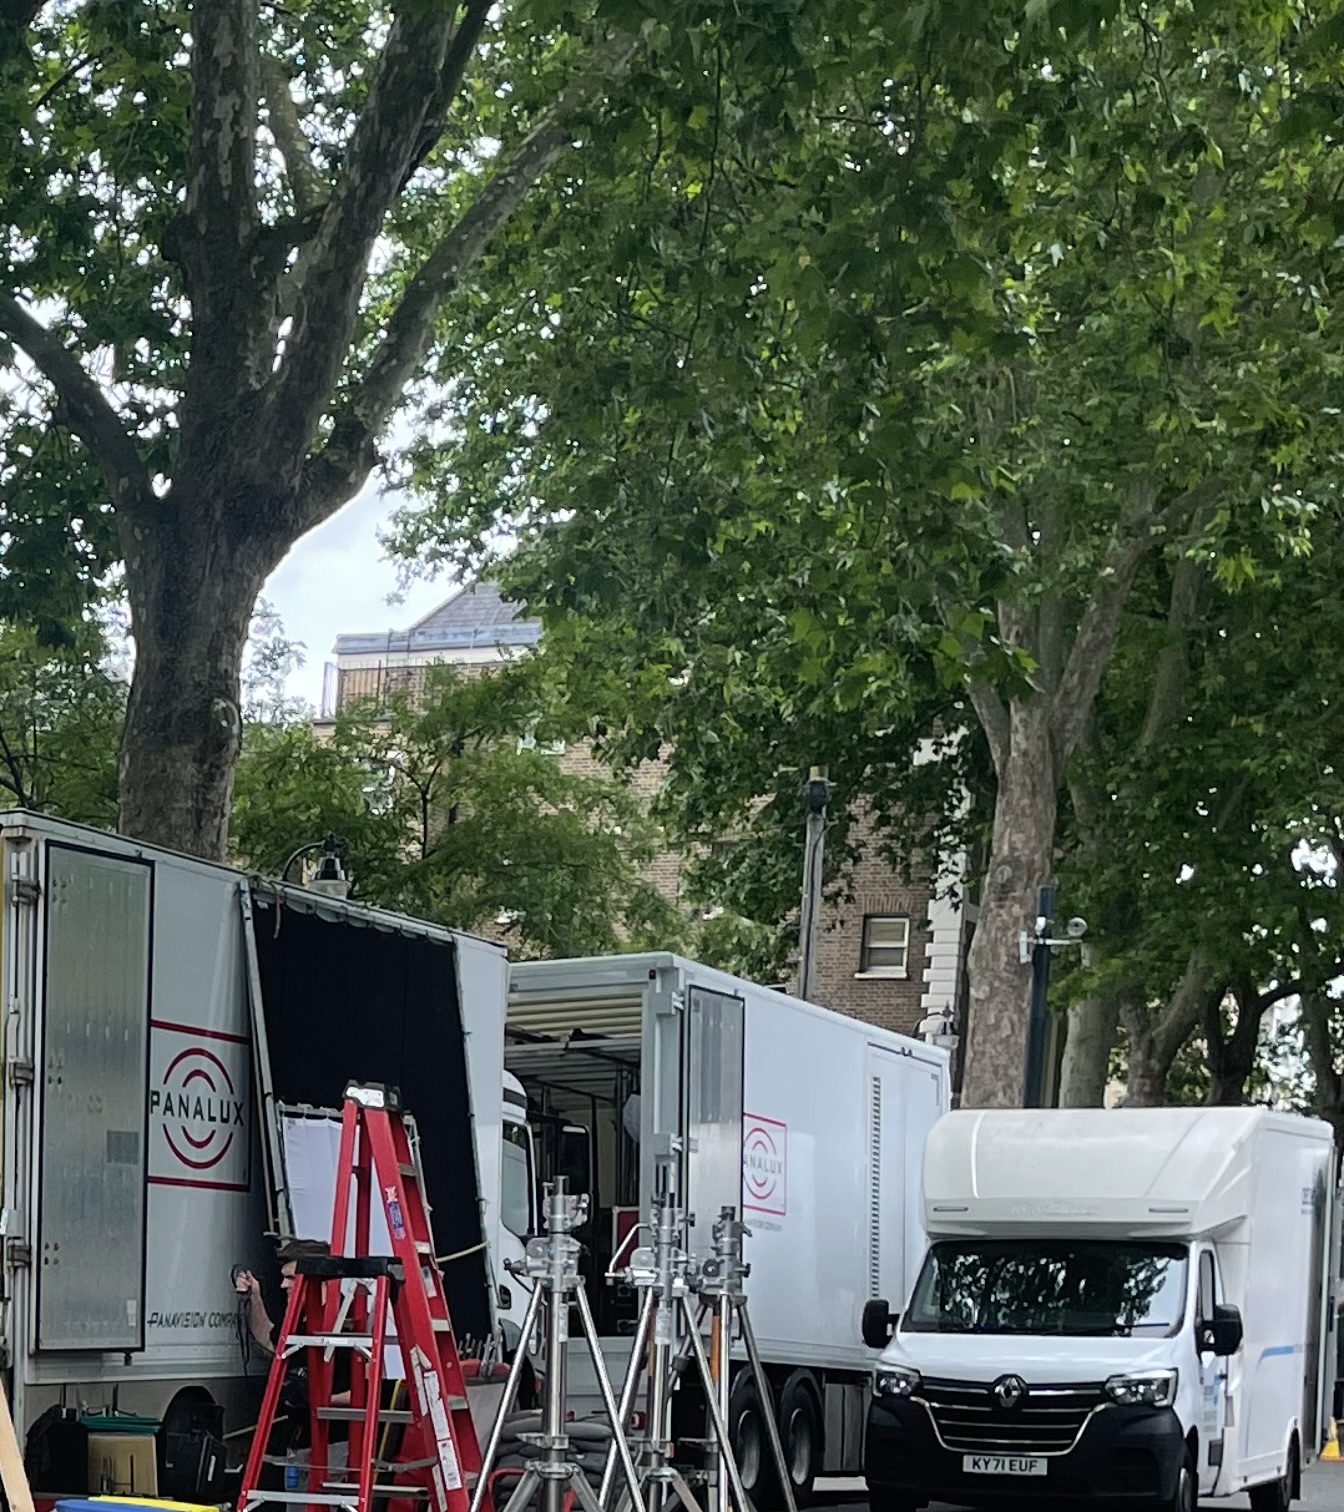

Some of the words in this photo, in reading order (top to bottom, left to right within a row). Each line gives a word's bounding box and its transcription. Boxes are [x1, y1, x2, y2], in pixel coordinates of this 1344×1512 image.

[149, 1089, 245, 1127] PANALUX
[743, 1154, 783, 1175] ANALUX
[147, 1312, 206, 1329] PANAVISION
[208, 1312, 238, 1329] COMPA
[972, 1457, 1005, 1472] KY71
[1009, 1458, 1038, 1473] EUF
